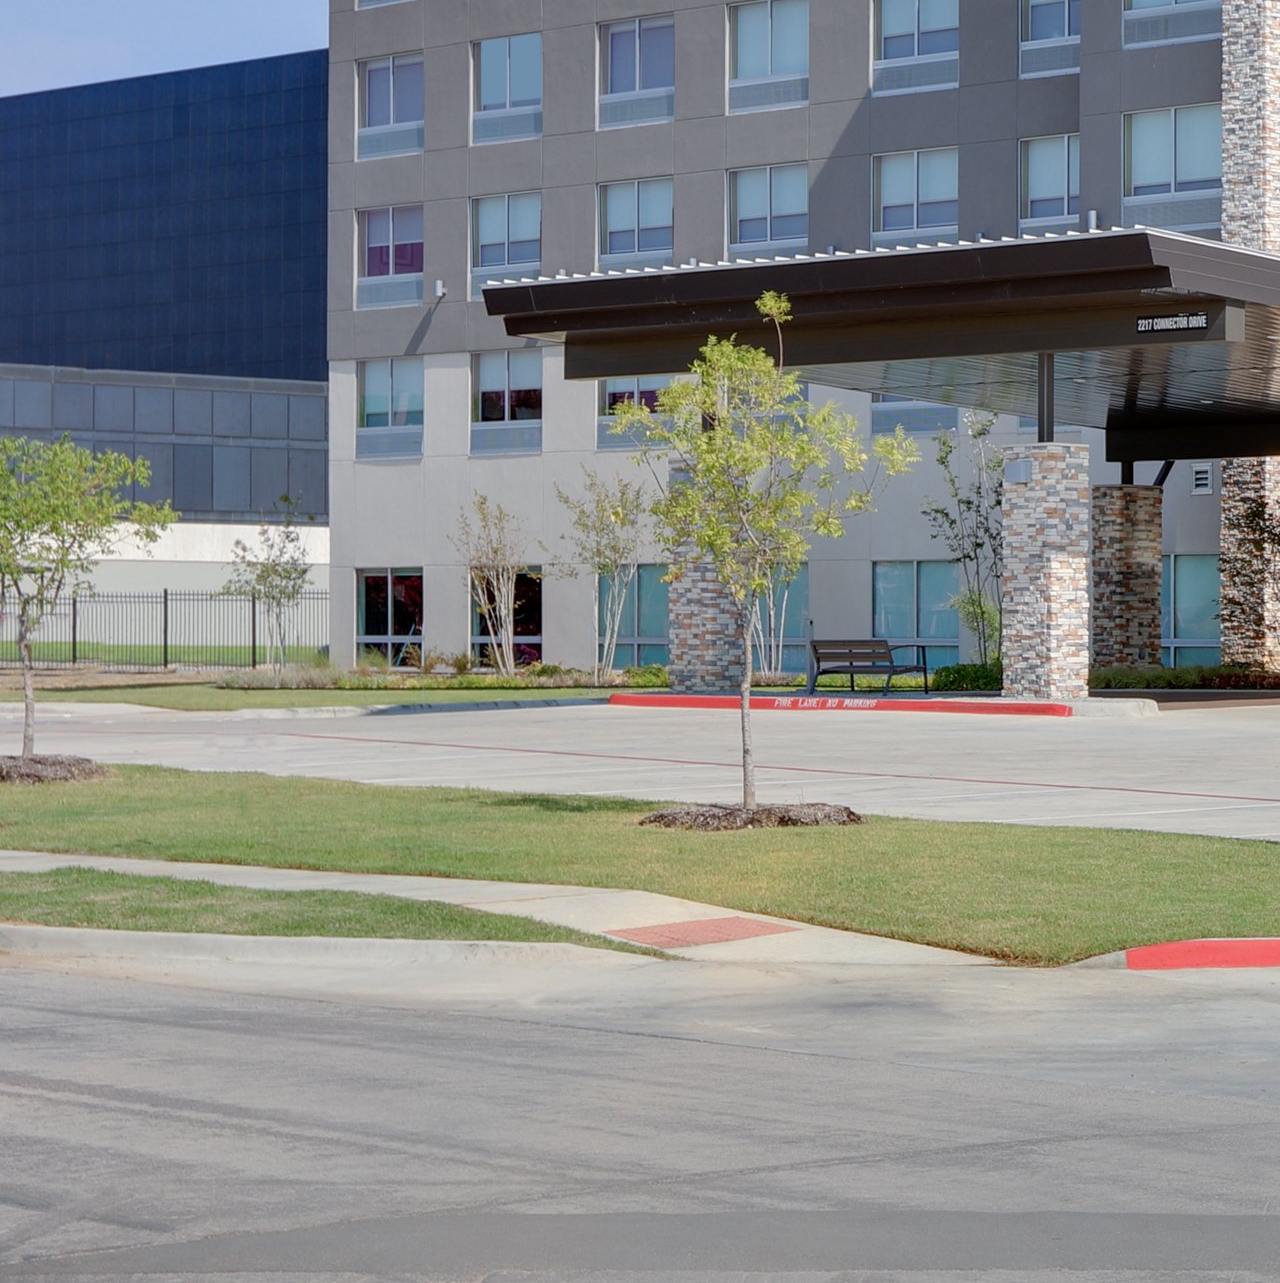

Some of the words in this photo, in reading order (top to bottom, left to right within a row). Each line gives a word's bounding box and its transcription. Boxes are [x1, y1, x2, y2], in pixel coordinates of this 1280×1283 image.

[1137, 319, 1152, 331] 2217
[1153, 317, 1188, 330] CONNECTOR
[1189, 316, 1207, 328] DRIVE
[774, 698, 793, 707] FIRE
[827, 699, 838, 707] NO
[843, 698, 877, 708] PARKING
